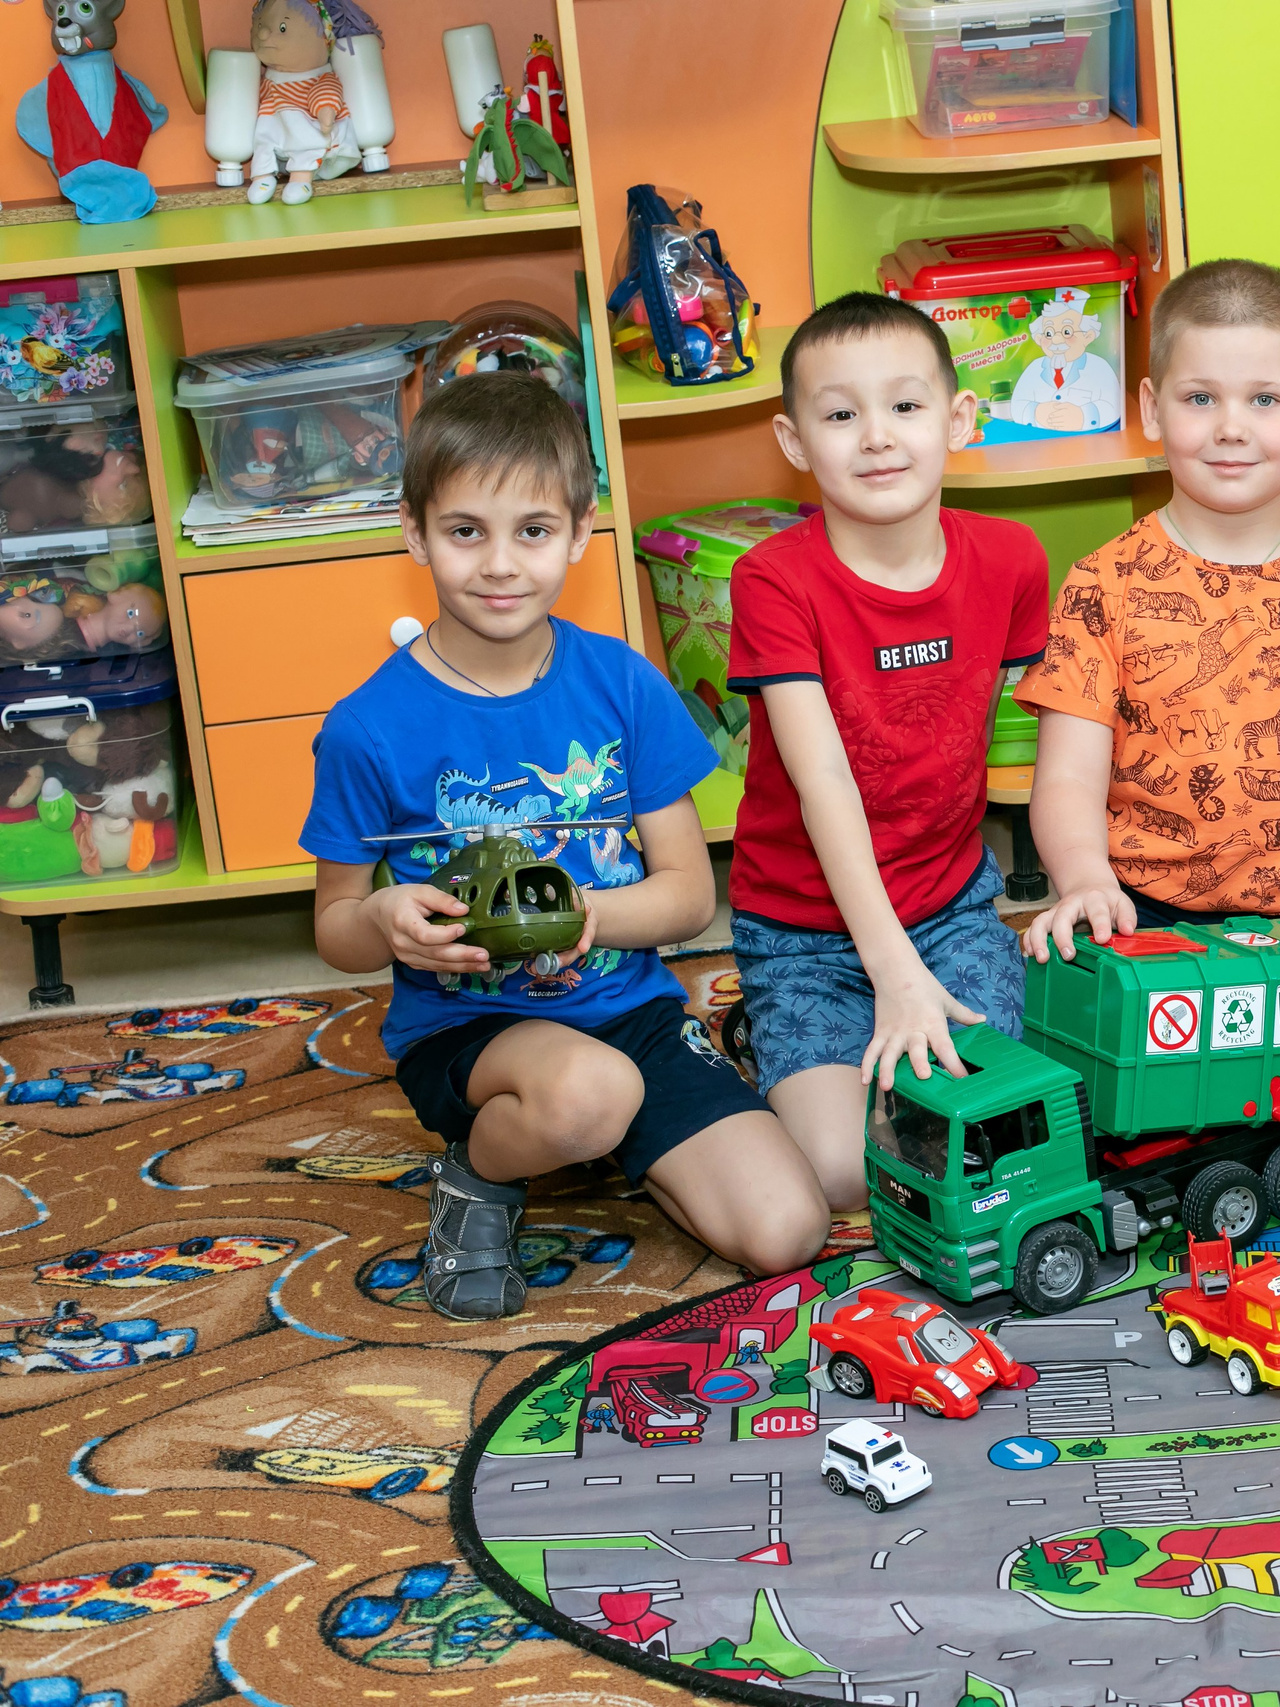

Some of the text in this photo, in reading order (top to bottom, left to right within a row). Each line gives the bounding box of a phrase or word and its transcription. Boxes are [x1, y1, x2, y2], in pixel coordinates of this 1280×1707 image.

[964, 111, 996, 123] ЛОТО
[931, 305, 1002, 323] Доктор
[987, 334, 1028, 353] здоровье
[970, 351, 1005, 370] вместе!
[880, 640, 948, 669] BE FIRST
[1221, 989, 1257, 1004] RECYCLING
[1218, 1029, 1256, 1044] RECYCLING
[890, 1180, 912, 1199] MAN
[973, 1191, 1009, 1212] bruder
[1114, 1331, 1143, 1348] P
[753, 1415, 816, 1433] STOP
